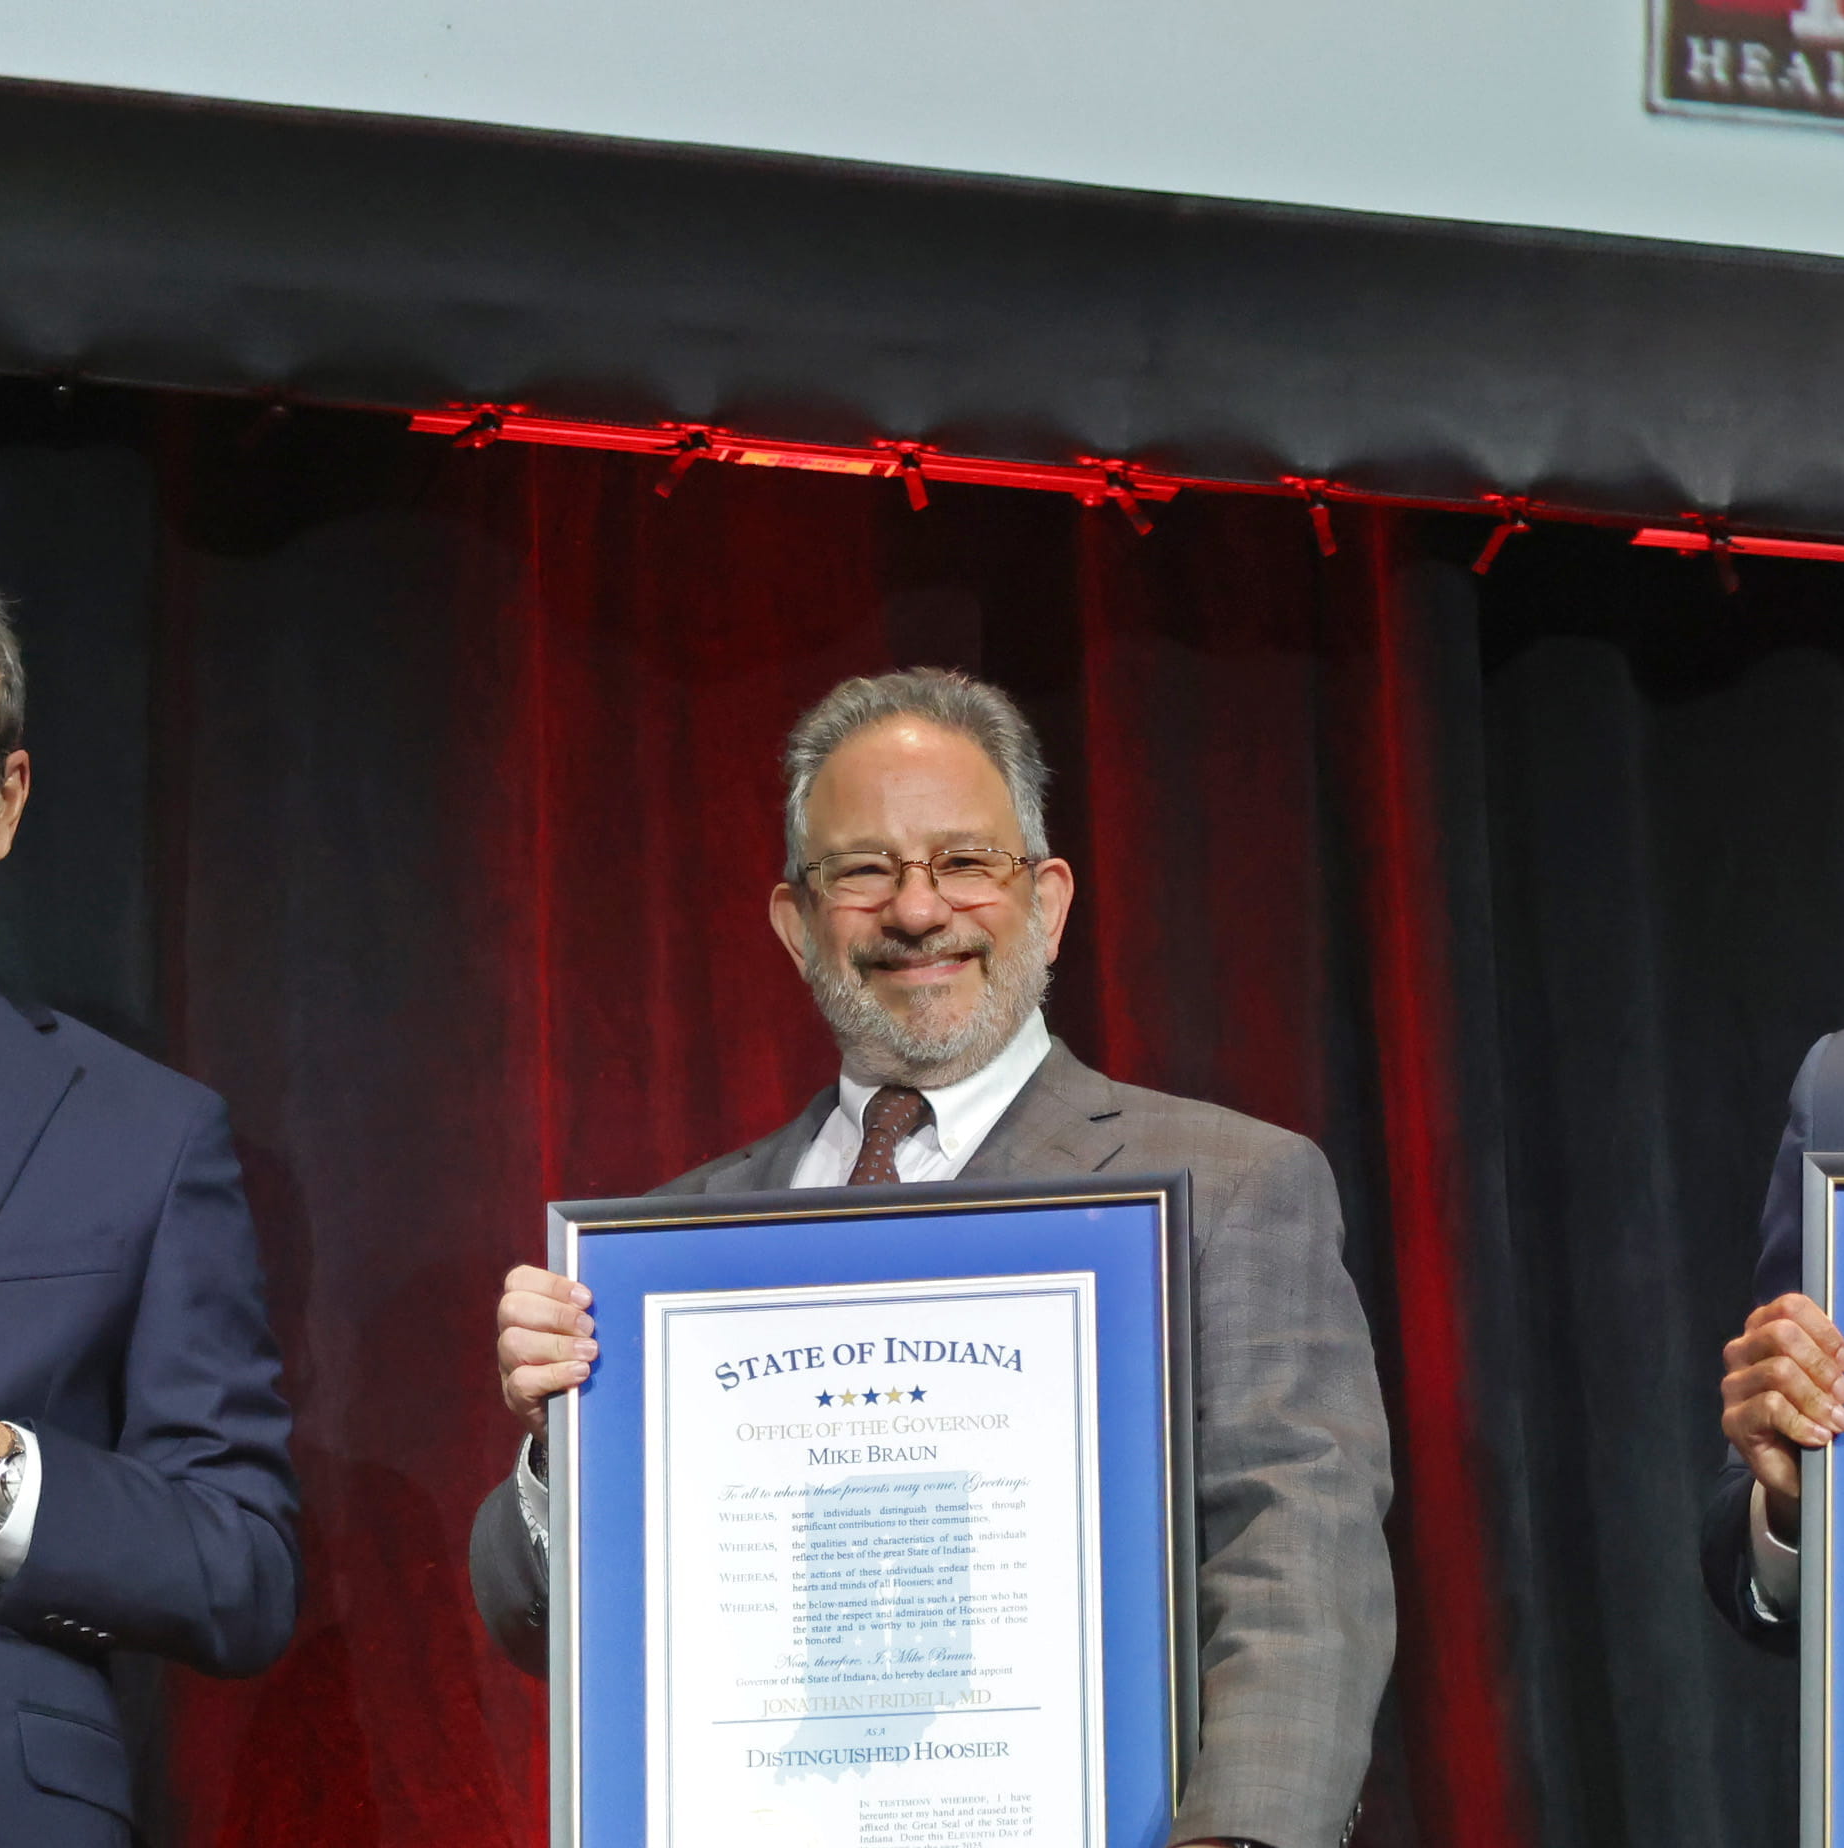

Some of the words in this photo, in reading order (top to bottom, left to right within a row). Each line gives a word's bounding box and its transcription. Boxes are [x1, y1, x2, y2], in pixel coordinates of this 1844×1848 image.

[714, 1346, 826, 1392] STATE
[832, 1342, 876, 1365] OF
[884, 1337, 1024, 1373] INDIANA
[736, 1423, 813, 1441] OFFICE
[816, 1421, 842, 1438] OF
[847, 1419, 888, 1435] THE
[891, 1413, 1010, 1434] GOVERNOR
[807, 1447, 862, 1466] MIKE
[867, 1445, 938, 1463] BRAUN
[717, 1484, 742, 1500] To
[740, 1487, 758, 1499] all
[758, 1487, 771, 1498] to
[773, 1484, 810, 1498] whom
[839, 1483, 890, 1500] presents
[893, 1483, 920, 1497] may
[791, 1511, 815, 1519] some
[823, 1507, 871, 1517] individuals
[879, 1504, 927, 1516] distinguish
[934, 1501, 983, 1512] themselves
[991, 1498, 1026, 1510] through
[791, 1521, 836, 1533] significant
[838, 1519, 896, 1529] contributions
[909, 1517, 929, 1526] their
[718, 1542, 778, 1552] WHEREAS,
[791, 1540, 806, 1549] the
[810, 1538, 847, 1550] qualities
[852, 1537, 868, 1546] and
[872, 1535, 935, 1546] characteristics
[939, 1533, 949, 1542] of
[953, 1532, 974, 1542] such
[978, 1529, 1026, 1540] individuals
[791, 1552, 818, 1562] reflect
[820, 1551, 835, 1561] the
[836, 1550, 854, 1560] best
[855, 1549, 867, 1559] of
[866, 1549, 882, 1558] the
[883, 1549, 905, 1559] great
[907, 1547, 929, 1556] State
[930, 1545, 941, 1555] of
[791, 1571, 806, 1580] the
[810, 1570, 842, 1579] actions
[845, 1567, 856, 1577] of
[859, 1567, 882, 1576] these
[886, 1564, 934, 1575] individuals
[938, 1563, 969, 1573] endear
[972, 1562, 995, 1571] them
[1013, 1560, 1027, 1569] the
[792, 1583, 818, 1592] hearts
[820, 1581, 837, 1591] and
[839, 1580, 866, 1590] minds
[868, 1579, 879, 1589] of
[879, 1578, 891, 1588] all
[936, 1575, 953, 1585] and
[888, 1648, 925, 1664] Mike
[735, 1678, 778, 1687] Governor
[779, 1675, 789, 1685] of
[791, 1675, 806, 1684] the
[806, 1674, 829, 1684] State
[831, 1673, 842, 1682] of
[843, 1672, 879, 1682] Indiana,
[880, 1671, 894, 1680] do
[894, 1669, 925, 1680] hereby
[926, 1668, 958, 1678] declare
[960, 1667, 977, 1676] and
[979, 1666, 1013, 1677] appoint
[761, 1694, 863, 1718] JONATHAN
[867, 1690, 955, 1709] FRIDELL,
[959, 1689, 991, 1705] MD
[745, 1745, 910, 1768] DISTINGUISHED
[914, 1741, 1010, 1761] HOOSIER
